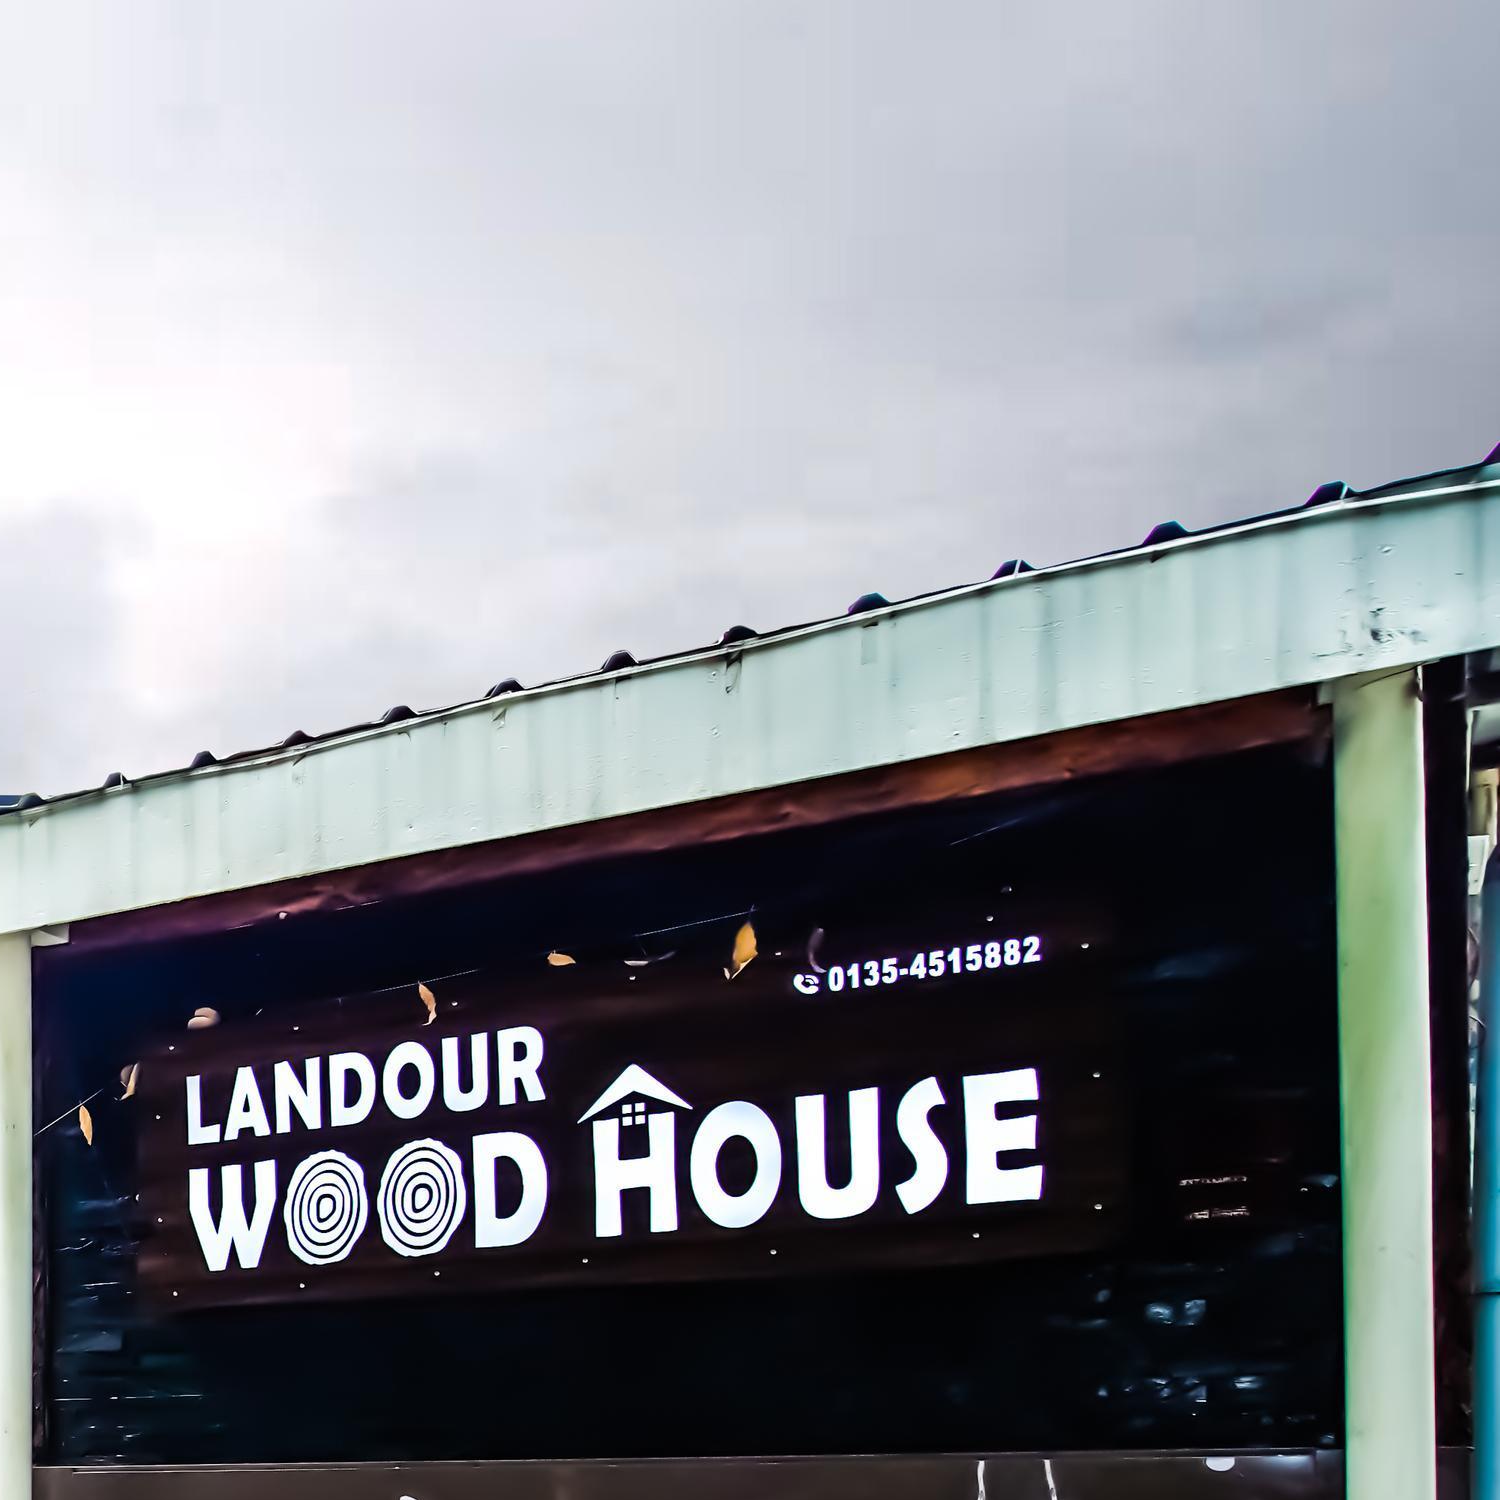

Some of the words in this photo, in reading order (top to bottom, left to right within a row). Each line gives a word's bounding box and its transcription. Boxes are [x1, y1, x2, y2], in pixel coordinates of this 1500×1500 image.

[828, 935, 1041, 992] 0135-4515882
[186, 1026, 546, 1146] LANDOUR
[188, 1131, 548, 1272] WOOD
[577, 1063, 1043, 1238] HOUSE
